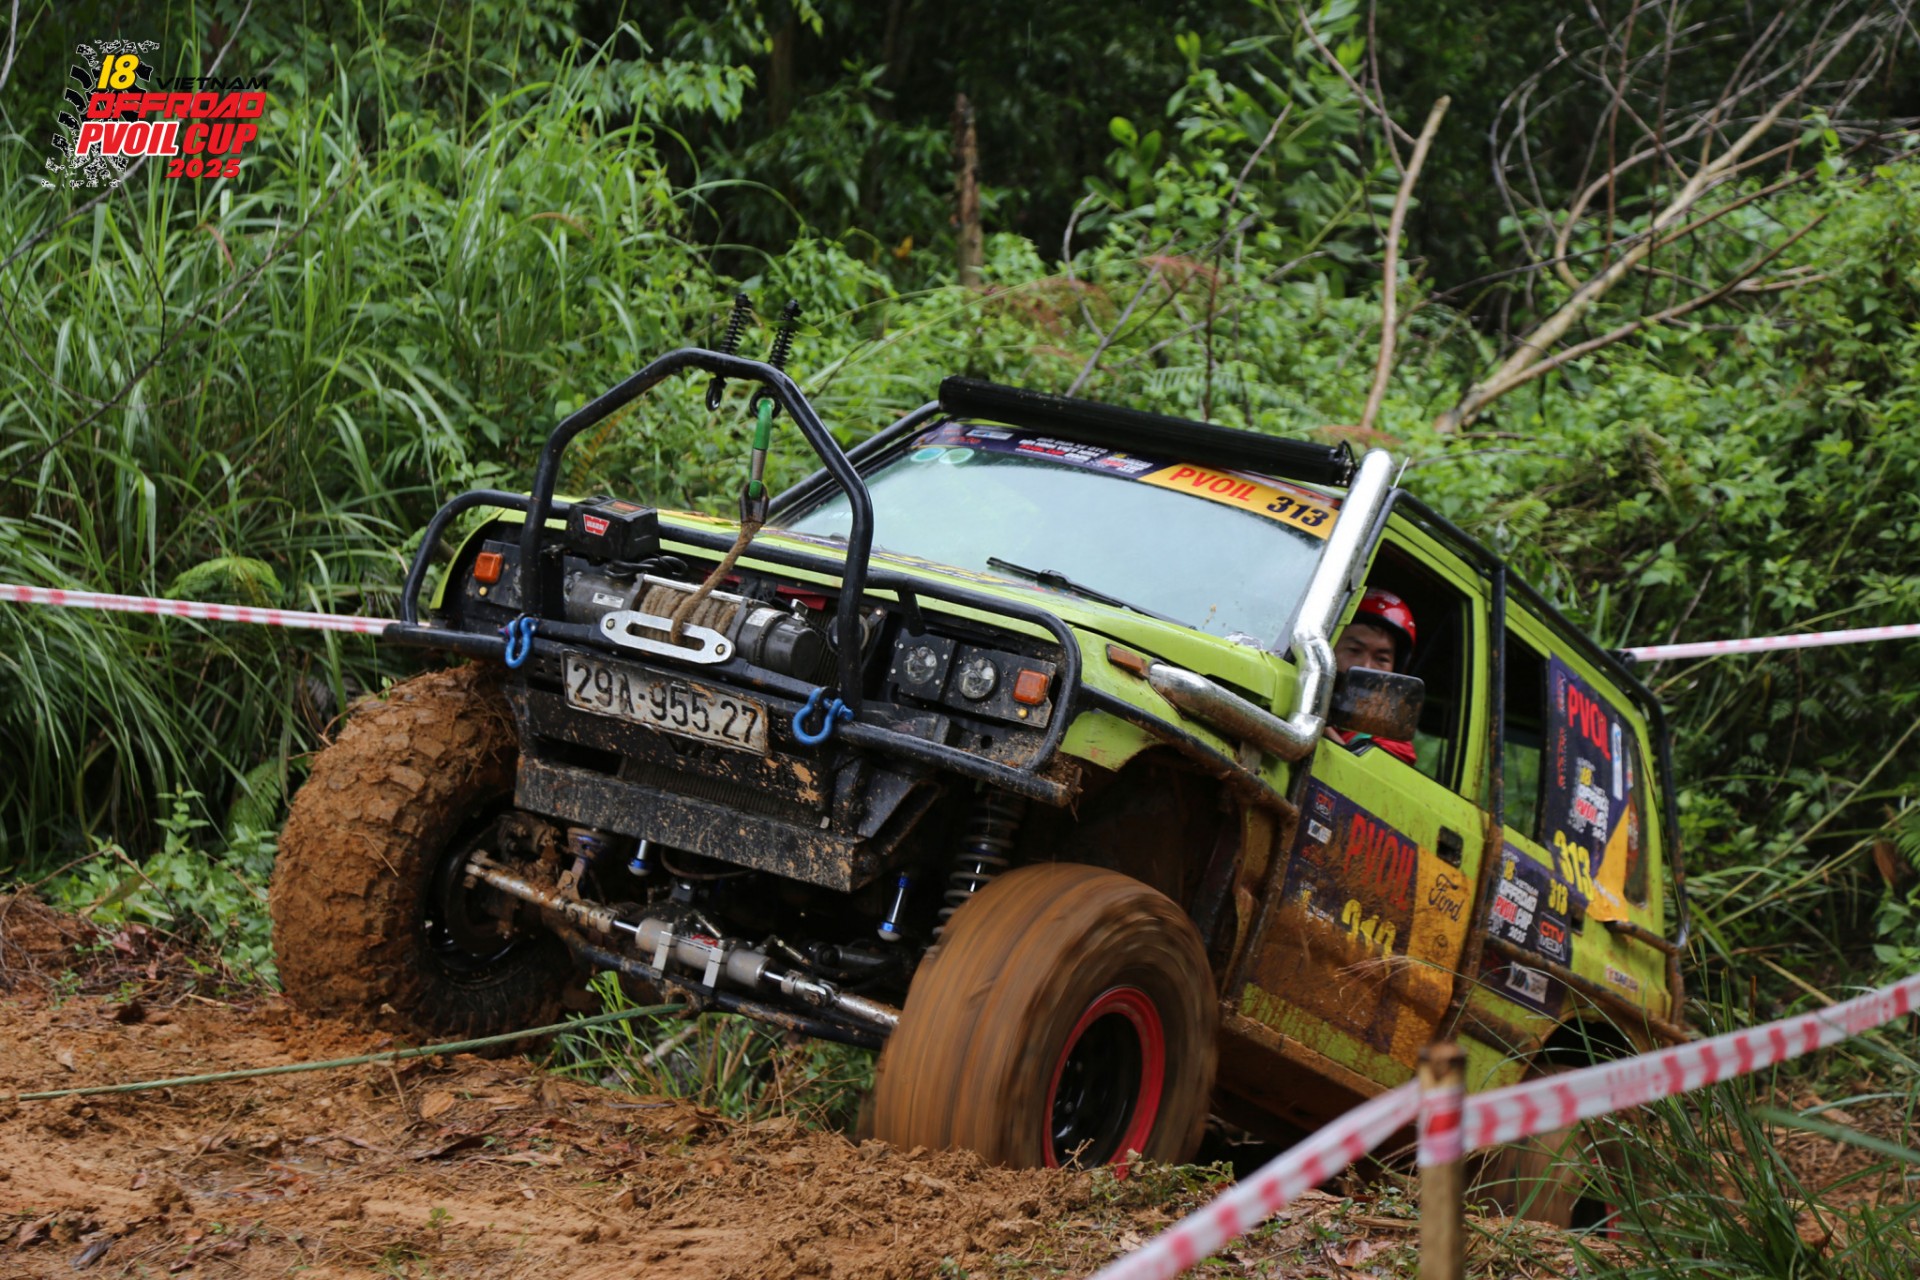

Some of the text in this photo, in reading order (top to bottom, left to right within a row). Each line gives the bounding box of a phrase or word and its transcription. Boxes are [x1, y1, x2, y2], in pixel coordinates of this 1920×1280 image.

[1169, 467, 1329, 527] PVOIL 313
[573, 663, 757, 743] 29A-955.27
[1568, 683, 1612, 762] PVOIL
[1343, 813, 1415, 911] PVOIL
[1428, 873, 1465, 922] Ford
[1548, 878, 1568, 916] 313
[1553, 830, 1594, 901] 313
